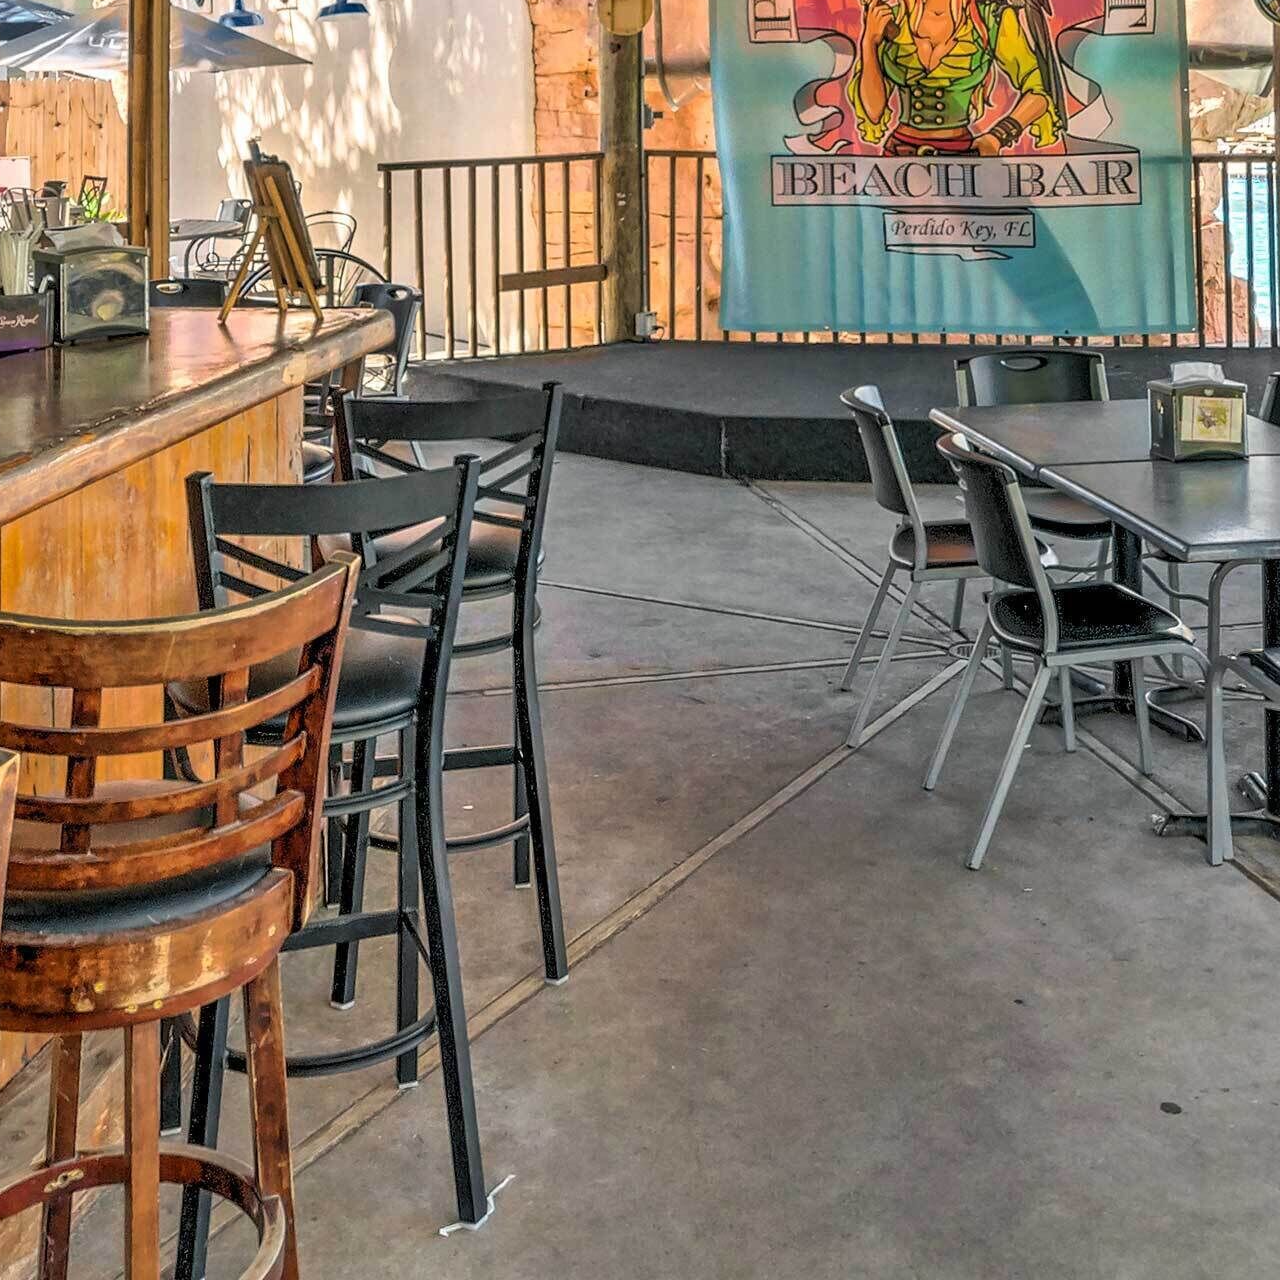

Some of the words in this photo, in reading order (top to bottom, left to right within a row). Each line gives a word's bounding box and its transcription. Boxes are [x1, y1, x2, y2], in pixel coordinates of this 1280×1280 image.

[776, 161, 983, 199] BEACH
[1001, 158, 1137, 199] BAR
[891, 218, 955, 237] Perdido
[958, 220, 998, 242] Key,
[1004, 220, 1032, 238] FL
